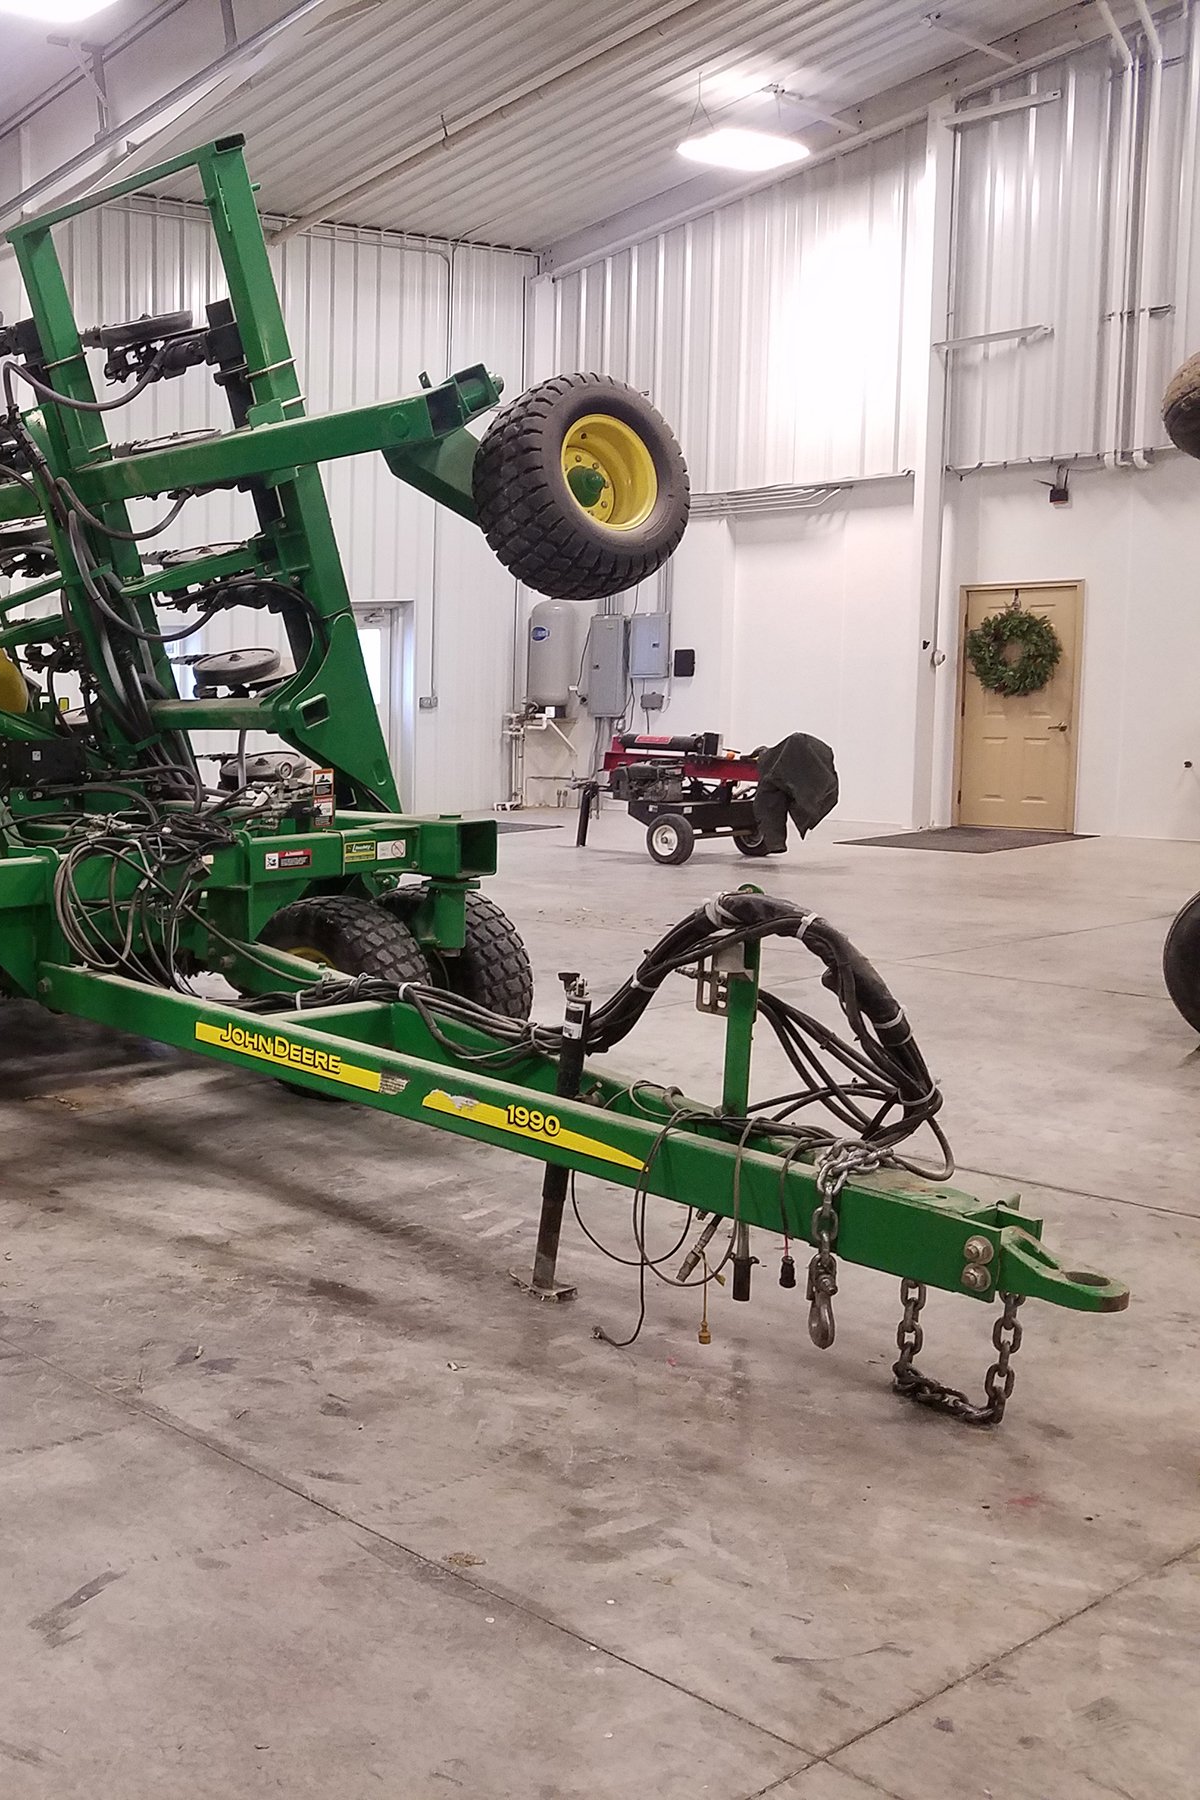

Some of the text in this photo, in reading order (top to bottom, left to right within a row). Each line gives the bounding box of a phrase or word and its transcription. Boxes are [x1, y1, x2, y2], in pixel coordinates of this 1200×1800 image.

[220, 1022, 341, 1074] JOHN DEERE
[506, 1104, 560, 1137] 1990
